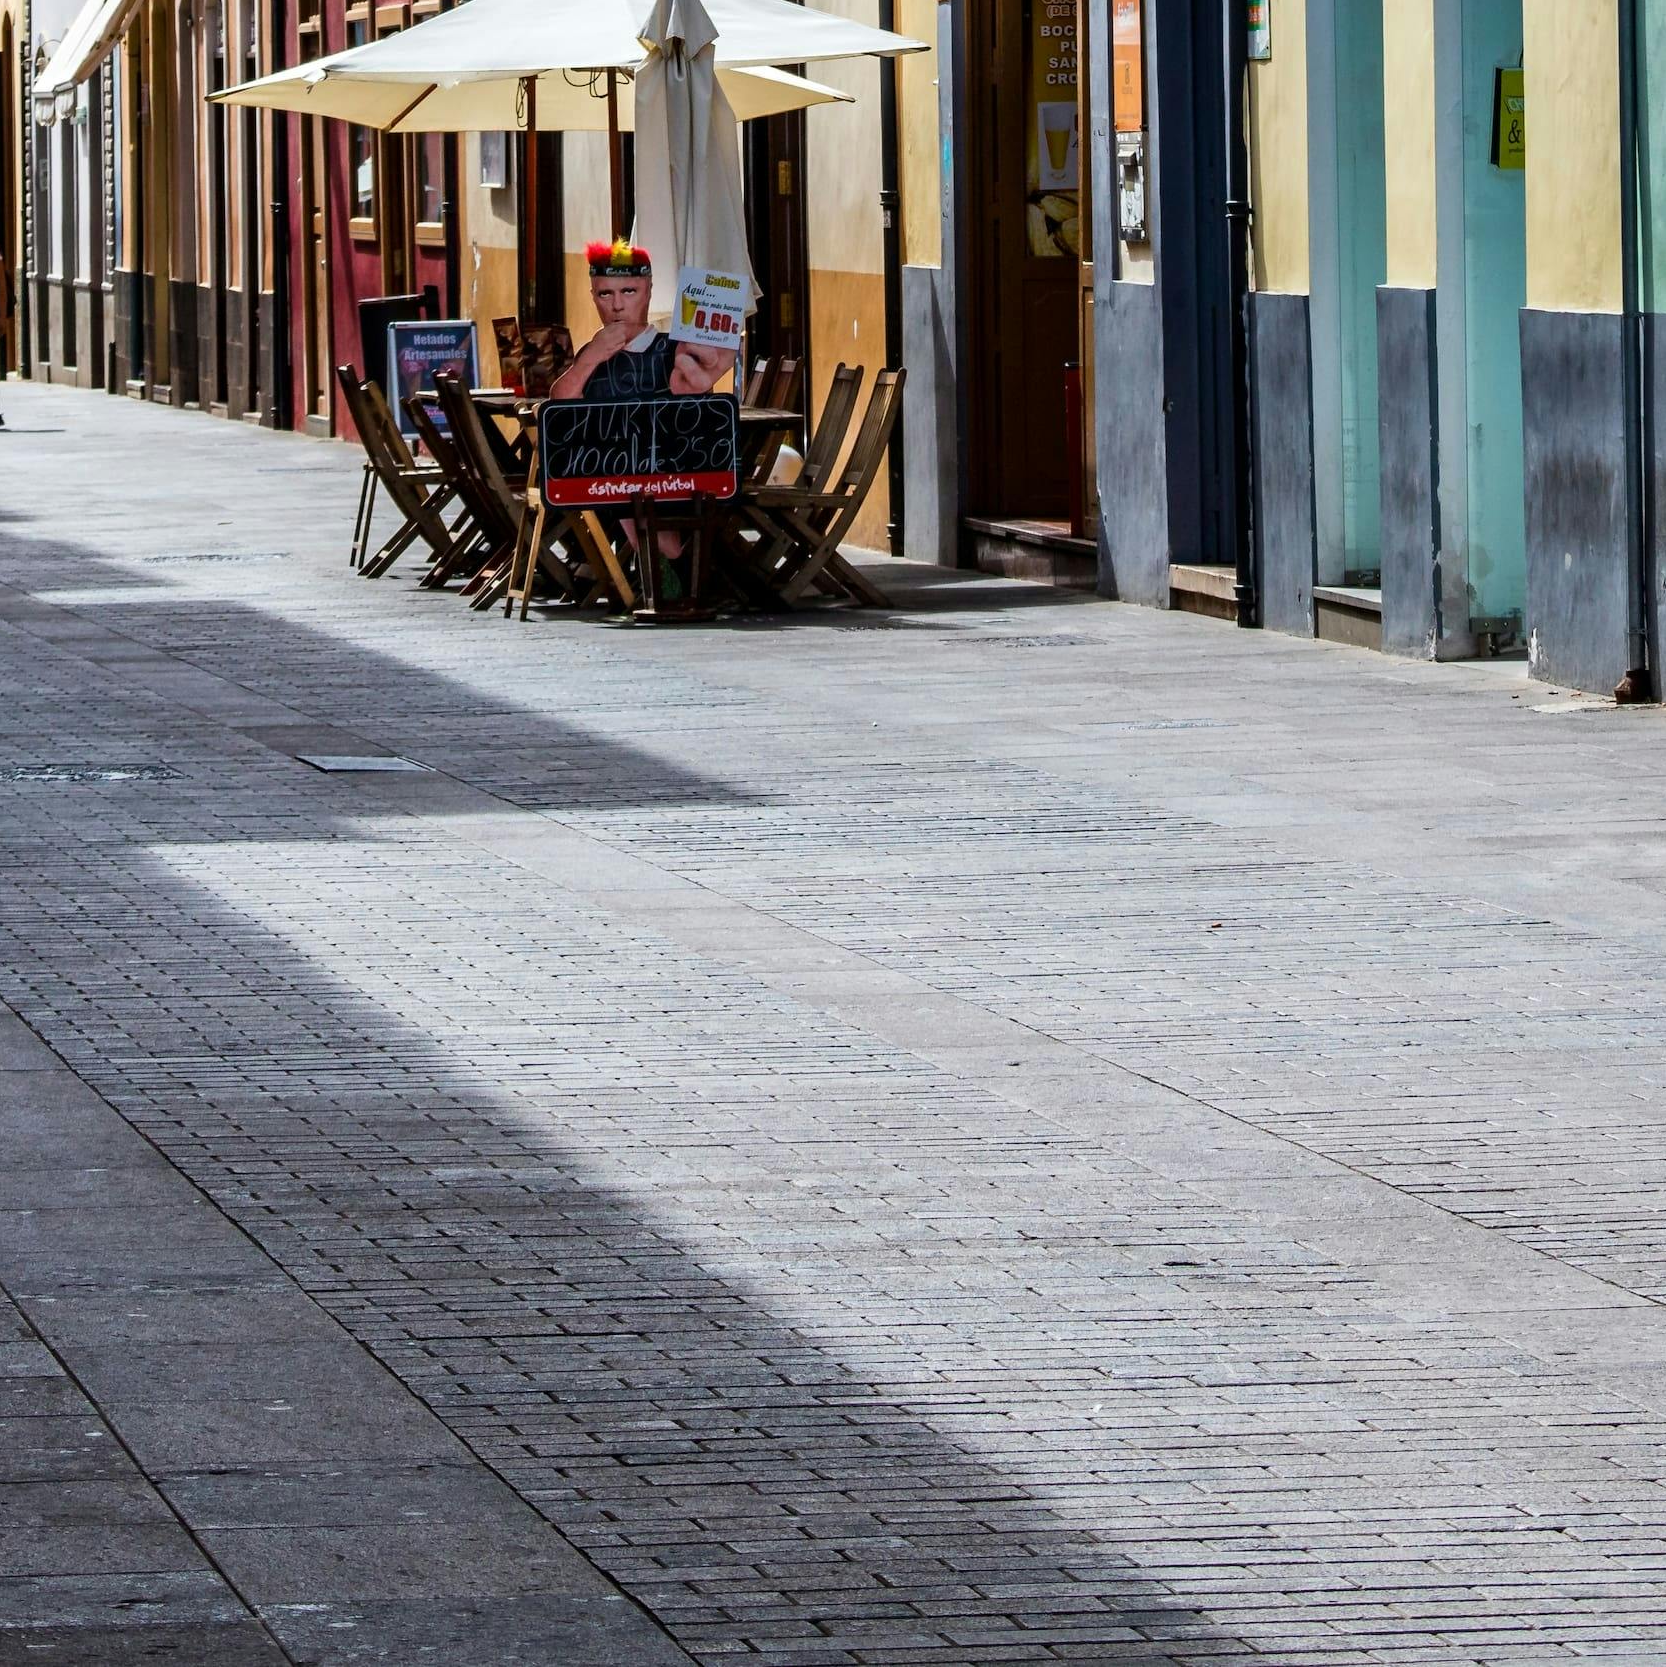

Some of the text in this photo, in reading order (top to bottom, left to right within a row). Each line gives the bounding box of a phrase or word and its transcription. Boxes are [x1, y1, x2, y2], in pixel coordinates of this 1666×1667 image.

[413, 334, 456, 345] Helados
[404, 349, 467, 360] Artesanales
[546, 395, 731, 445] CHURROS
[588, 481, 643, 496] disfrutar
[644, 480, 661, 494] del
